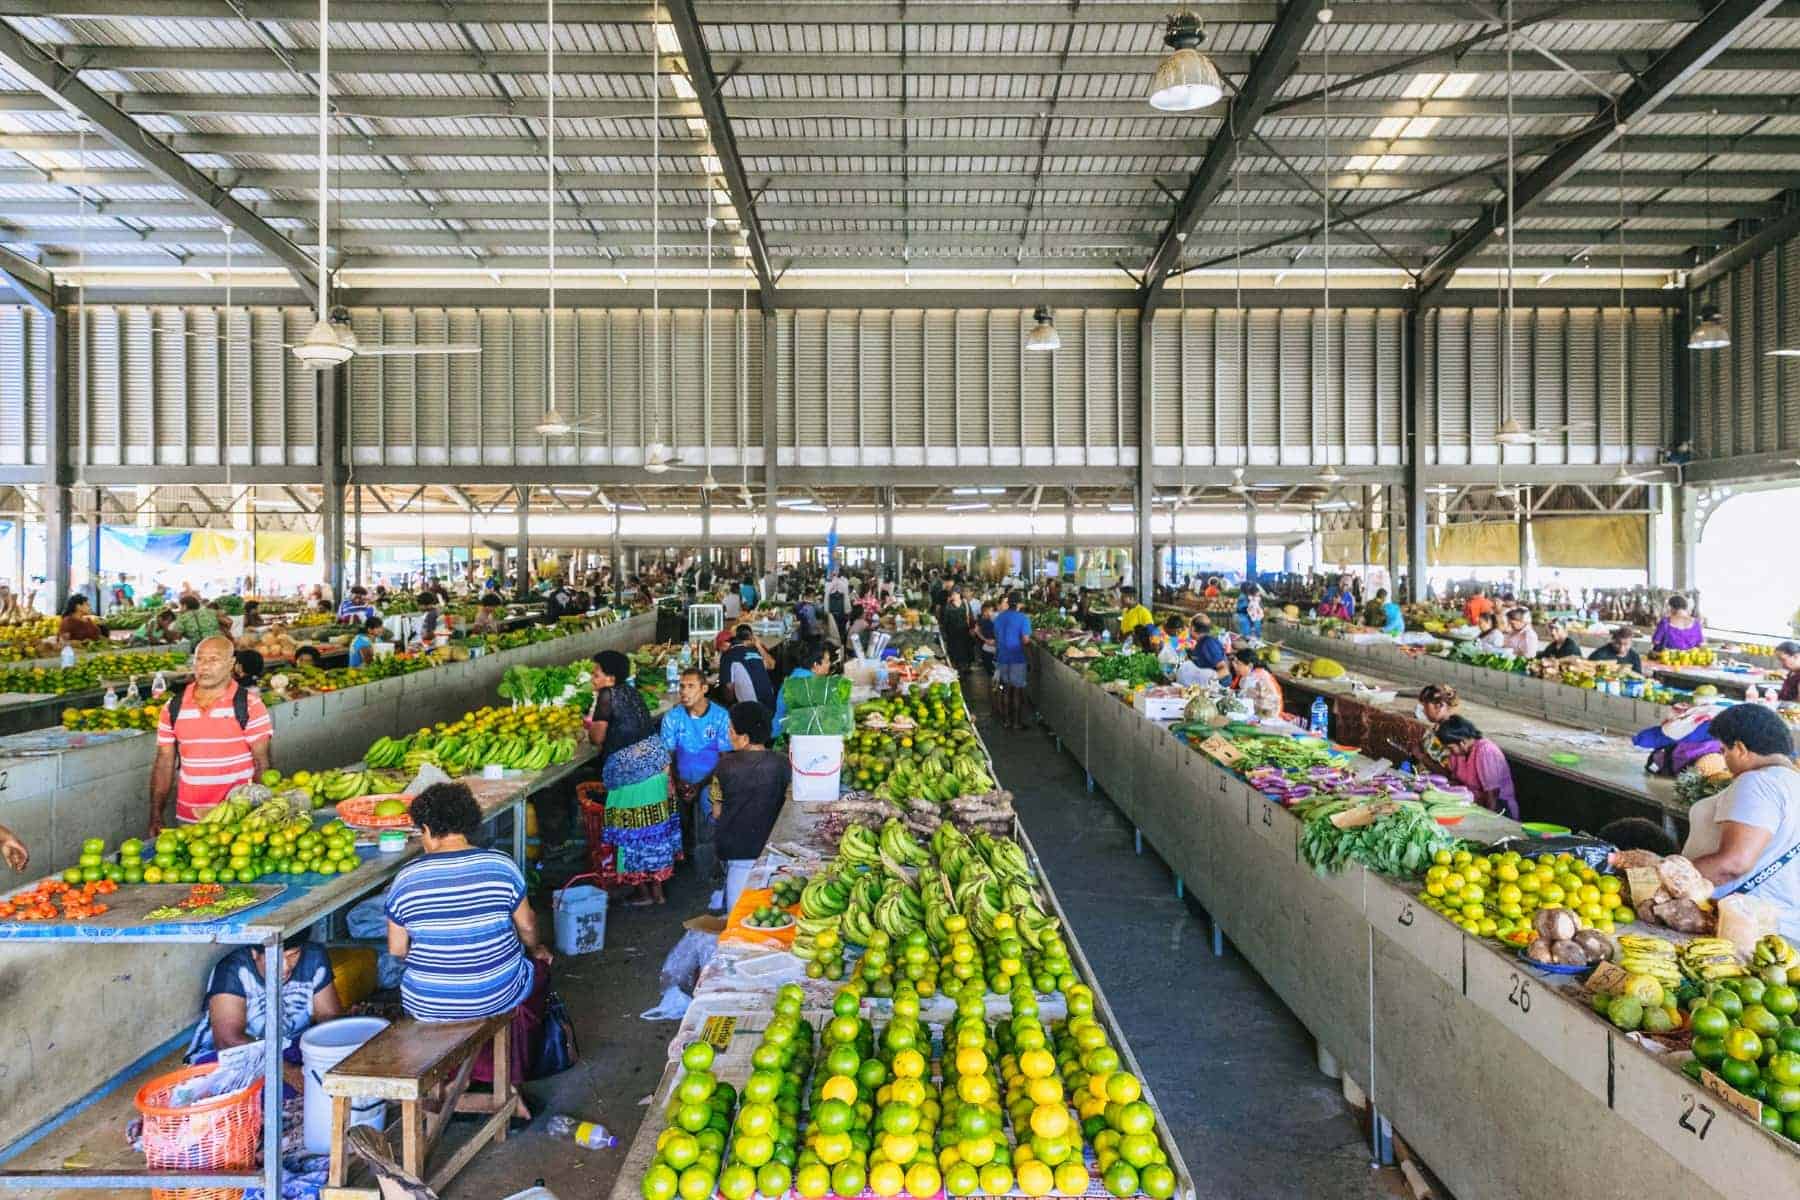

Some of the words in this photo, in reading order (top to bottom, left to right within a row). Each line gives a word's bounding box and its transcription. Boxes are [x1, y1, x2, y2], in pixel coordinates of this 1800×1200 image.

[1753, 861, 1783, 885] adidas
[1398, 897, 1414, 926] 25
[1509, 973, 1530, 1013] 26
[1679, 1093, 1716, 1140] 27
